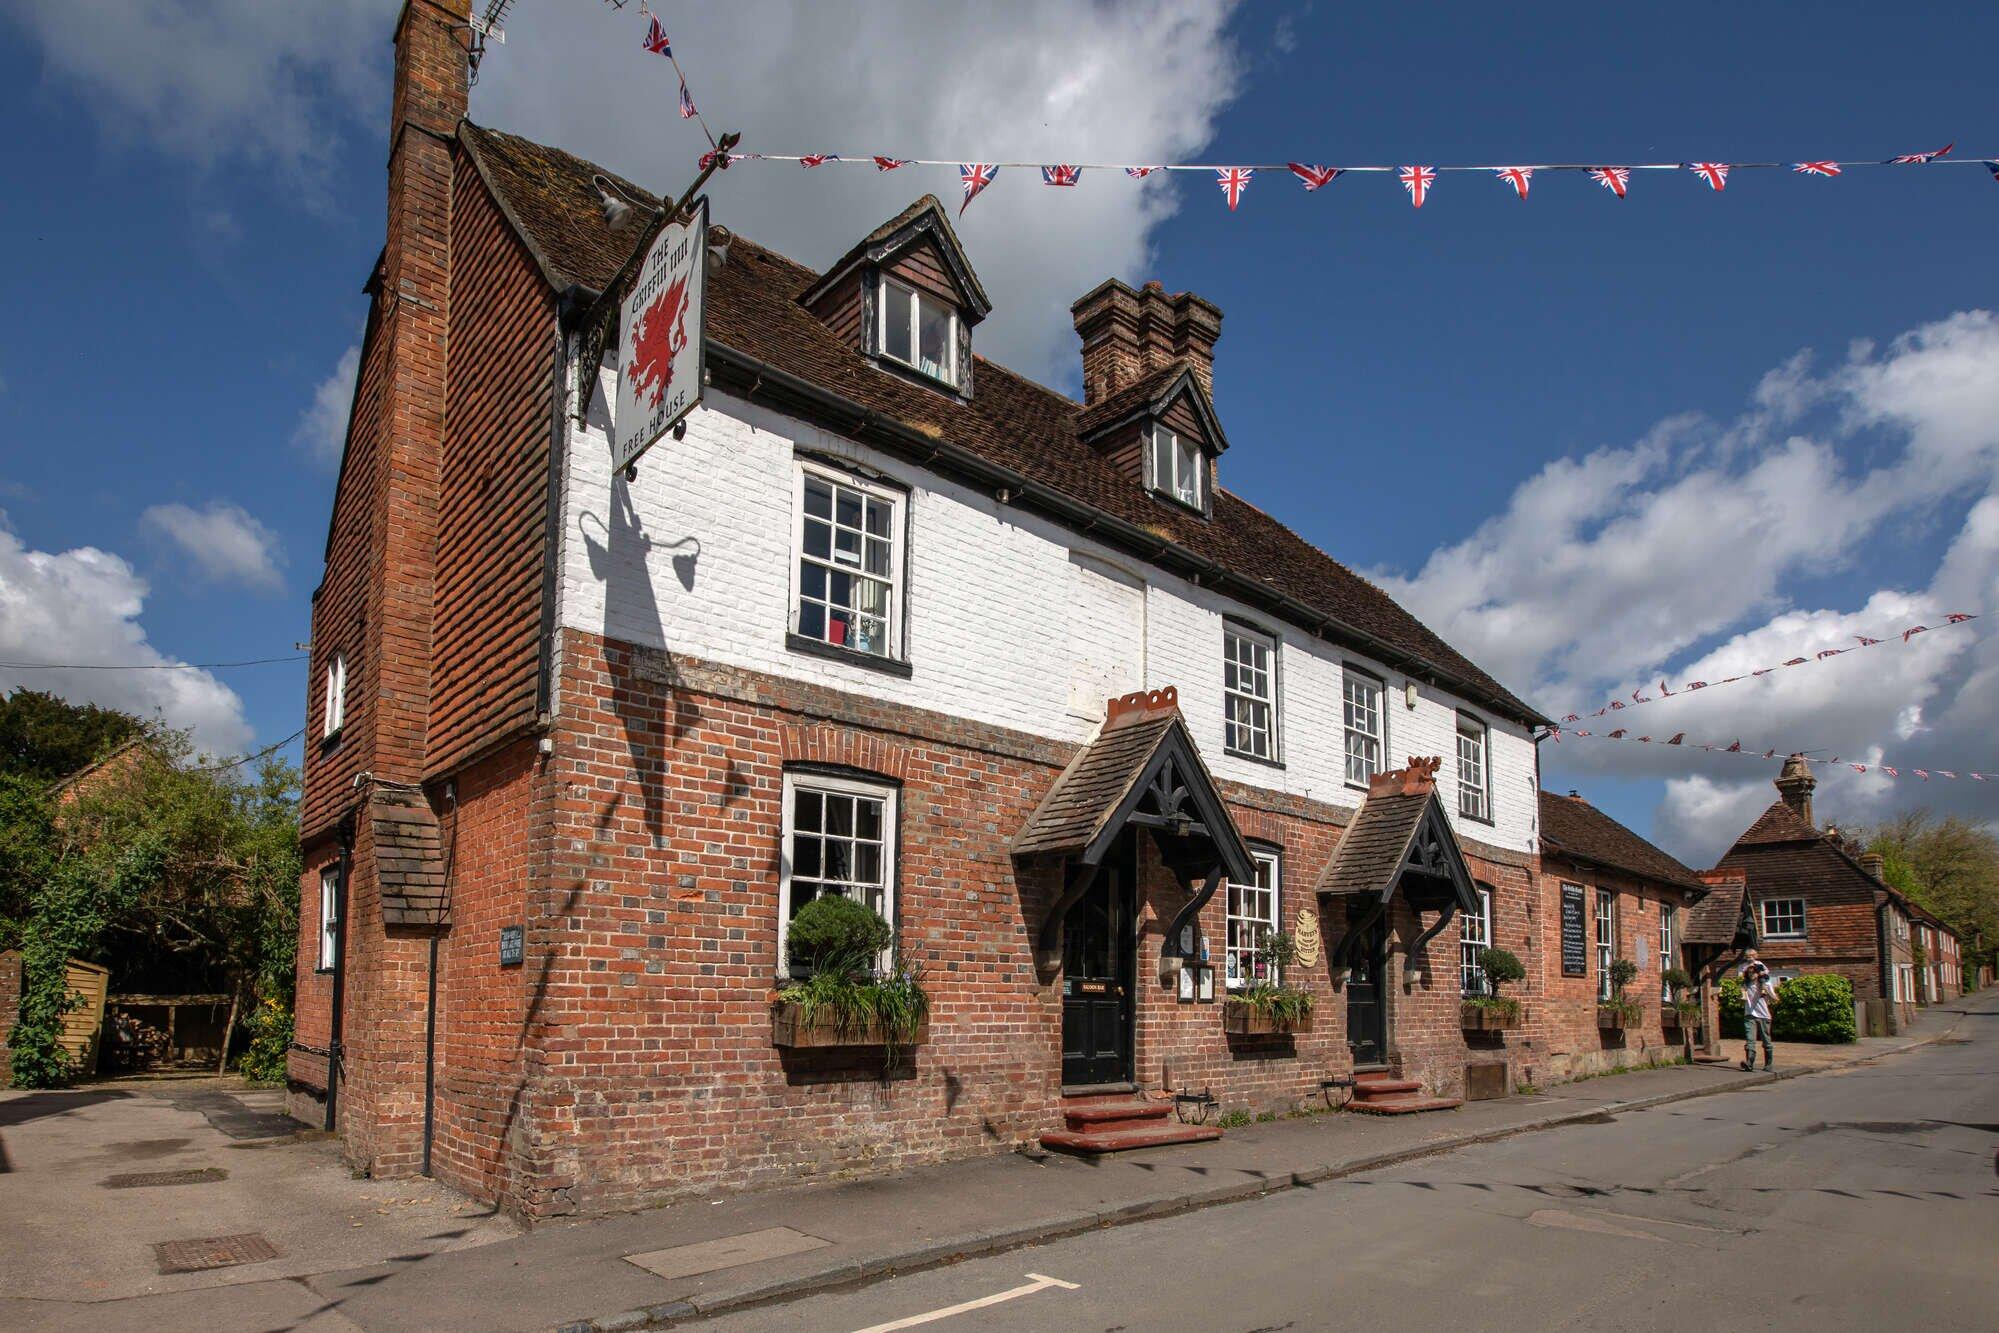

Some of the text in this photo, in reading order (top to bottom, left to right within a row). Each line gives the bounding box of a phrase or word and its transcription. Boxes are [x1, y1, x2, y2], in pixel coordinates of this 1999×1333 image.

[632, 237, 688, 314] GRIFFIN INN
[651, 238, 669, 271] THE
[622, 389, 685, 458] FREE HOUSE
